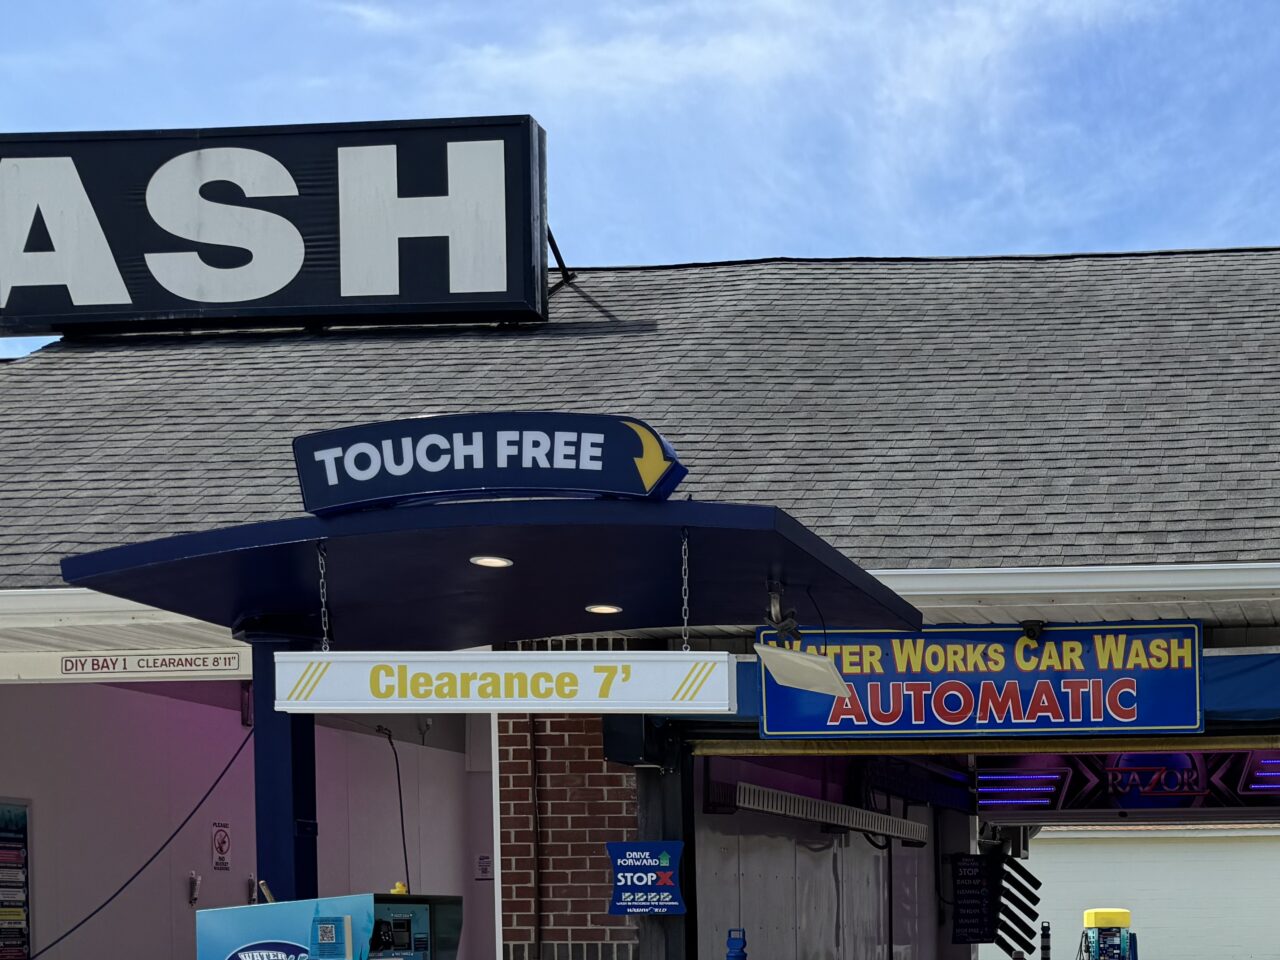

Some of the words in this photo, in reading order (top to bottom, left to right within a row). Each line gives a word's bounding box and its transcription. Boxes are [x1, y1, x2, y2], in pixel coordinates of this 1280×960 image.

[314, 431, 484, 486] TOUCH
[496, 430, 605, 470] FREE
[64, 659, 87, 671] DIY
[92, 658, 118, 670] BAY
[123, 658, 127, 670] 1
[138, 657, 208, 669] CLEARANCE
[892, 638, 1005, 673] WORKS
[1015, 636, 1083, 671] CAR
[1095, 634, 1193, 670] WASH
[370, 663, 579, 701] Clearance
[827, 677, 1138, 726] AUTOMATIC
[1105, 767, 1211, 796] RAZOR
[617, 873, 657, 885] STOP
